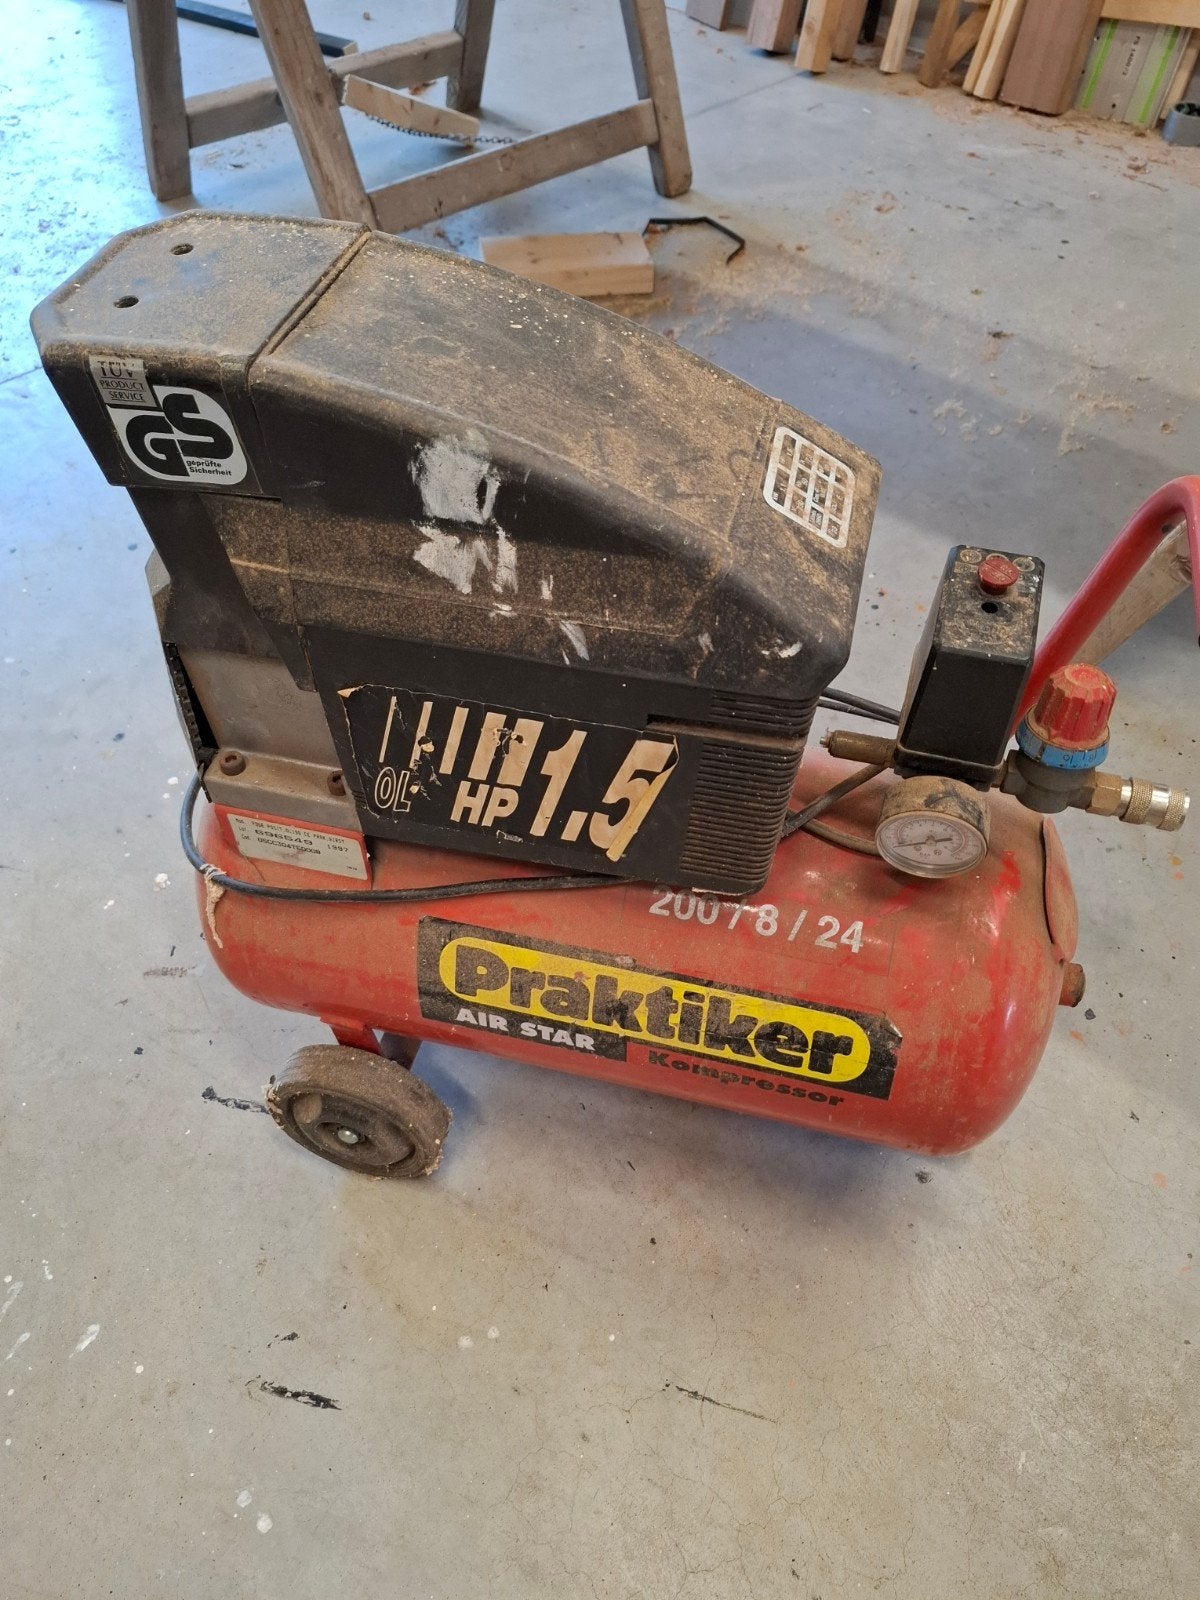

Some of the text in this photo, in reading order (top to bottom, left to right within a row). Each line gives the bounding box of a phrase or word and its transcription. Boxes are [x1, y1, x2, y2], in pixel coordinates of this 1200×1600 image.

[99, 380, 145, 391] PRODUCT
[110, 391, 145, 402] SERVICE
[126, 393, 234, 477] GS
[186, 459, 222, 469] geprüfte
[189, 465, 232, 476] Sicherheit
[450, 780, 520, 828] HP
[529, 729, 676, 855] 1.5
[649, 884, 720, 925] 200
[755, 904, 779, 937] 8
[814, 915, 864, 954] 24
[454, 944, 854, 1076] Praktiker
[455, 1006, 597, 1052] AIR STAR
[647, 1050, 845, 1106] Kompressor
